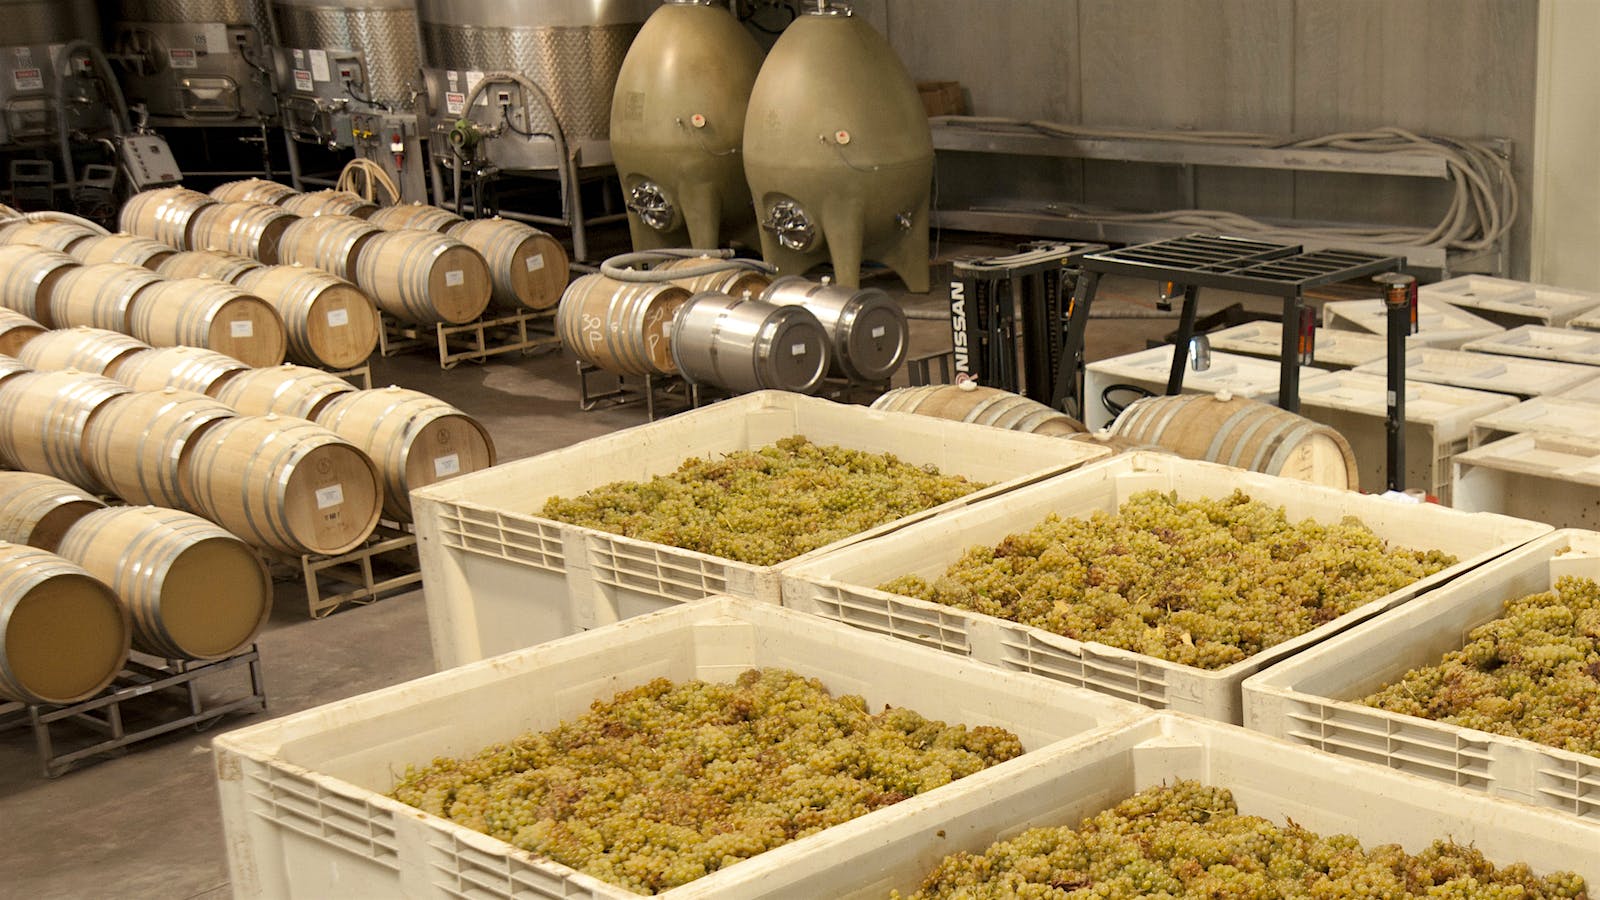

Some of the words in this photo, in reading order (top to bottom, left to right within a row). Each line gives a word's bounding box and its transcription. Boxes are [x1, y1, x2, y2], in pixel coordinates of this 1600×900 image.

[582, 313, 601, 332] 30
[951, 282, 969, 372] NISSAN
[589, 331, 603, 353] P
[648, 333, 660, 362] P
